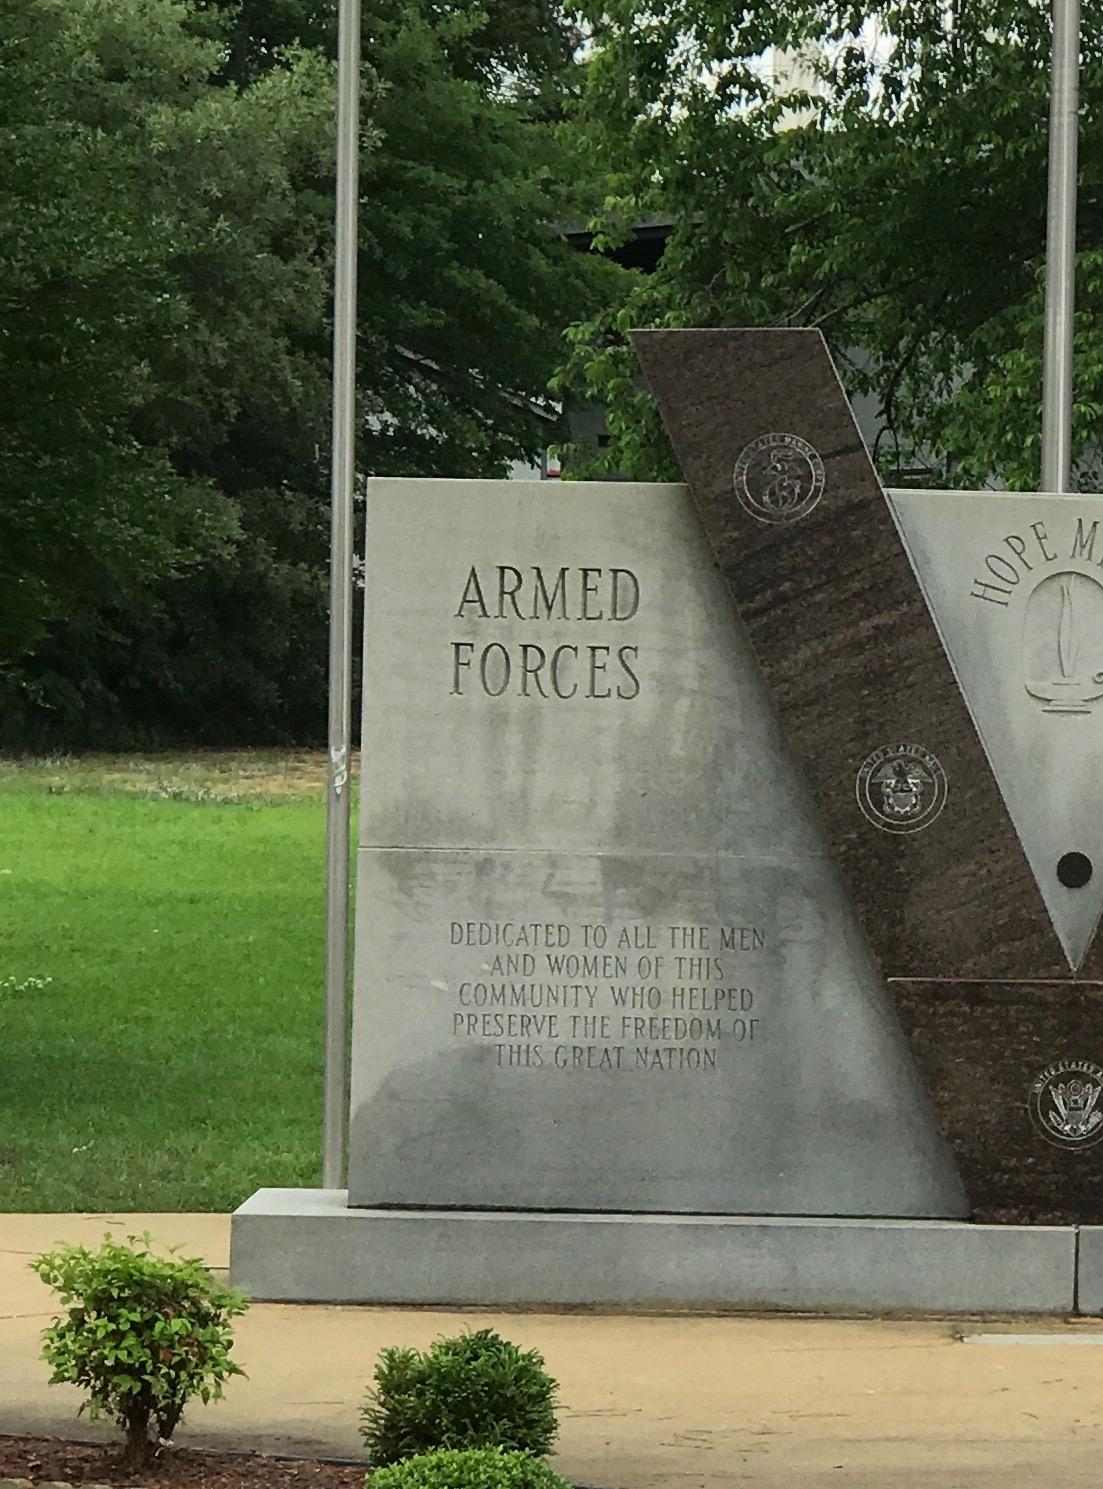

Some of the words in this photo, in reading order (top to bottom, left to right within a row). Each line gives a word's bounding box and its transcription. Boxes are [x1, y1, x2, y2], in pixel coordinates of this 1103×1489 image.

[969, 520, 1057, 608] HOPE
[453, 564, 641, 622] ARMED
[449, 641, 641, 700] FORCES
[450, 922, 570, 948] DEDICATED
[581, 924, 607, 949] TO
[617, 926, 656, 950] ALL
[669, 926, 709, 950] THE
[719, 927, 766, 951] MEN
[490, 954, 536, 977] AND
[546, 954, 627, 979] WOMEN
[637, 956, 664, 980] OF
[674, 957, 724, 981] THIS
[459, 983, 598, 1009] COMMUNITY
[610, 985, 662, 1010] WHO
[672, 987, 754, 1012] HELPED
[453, 1013, 559, 1038] PRESERVE
[569, 1015, 610, 1040] THE
[621, 1016, 722, 1041] FREEDOM
[733, 1018, 759, 1042] OF
[494, 1043, 543, 1067] THIS
[554, 1045, 625, 1069] GREAT
[635, 1047, 717, 1071] NATION
